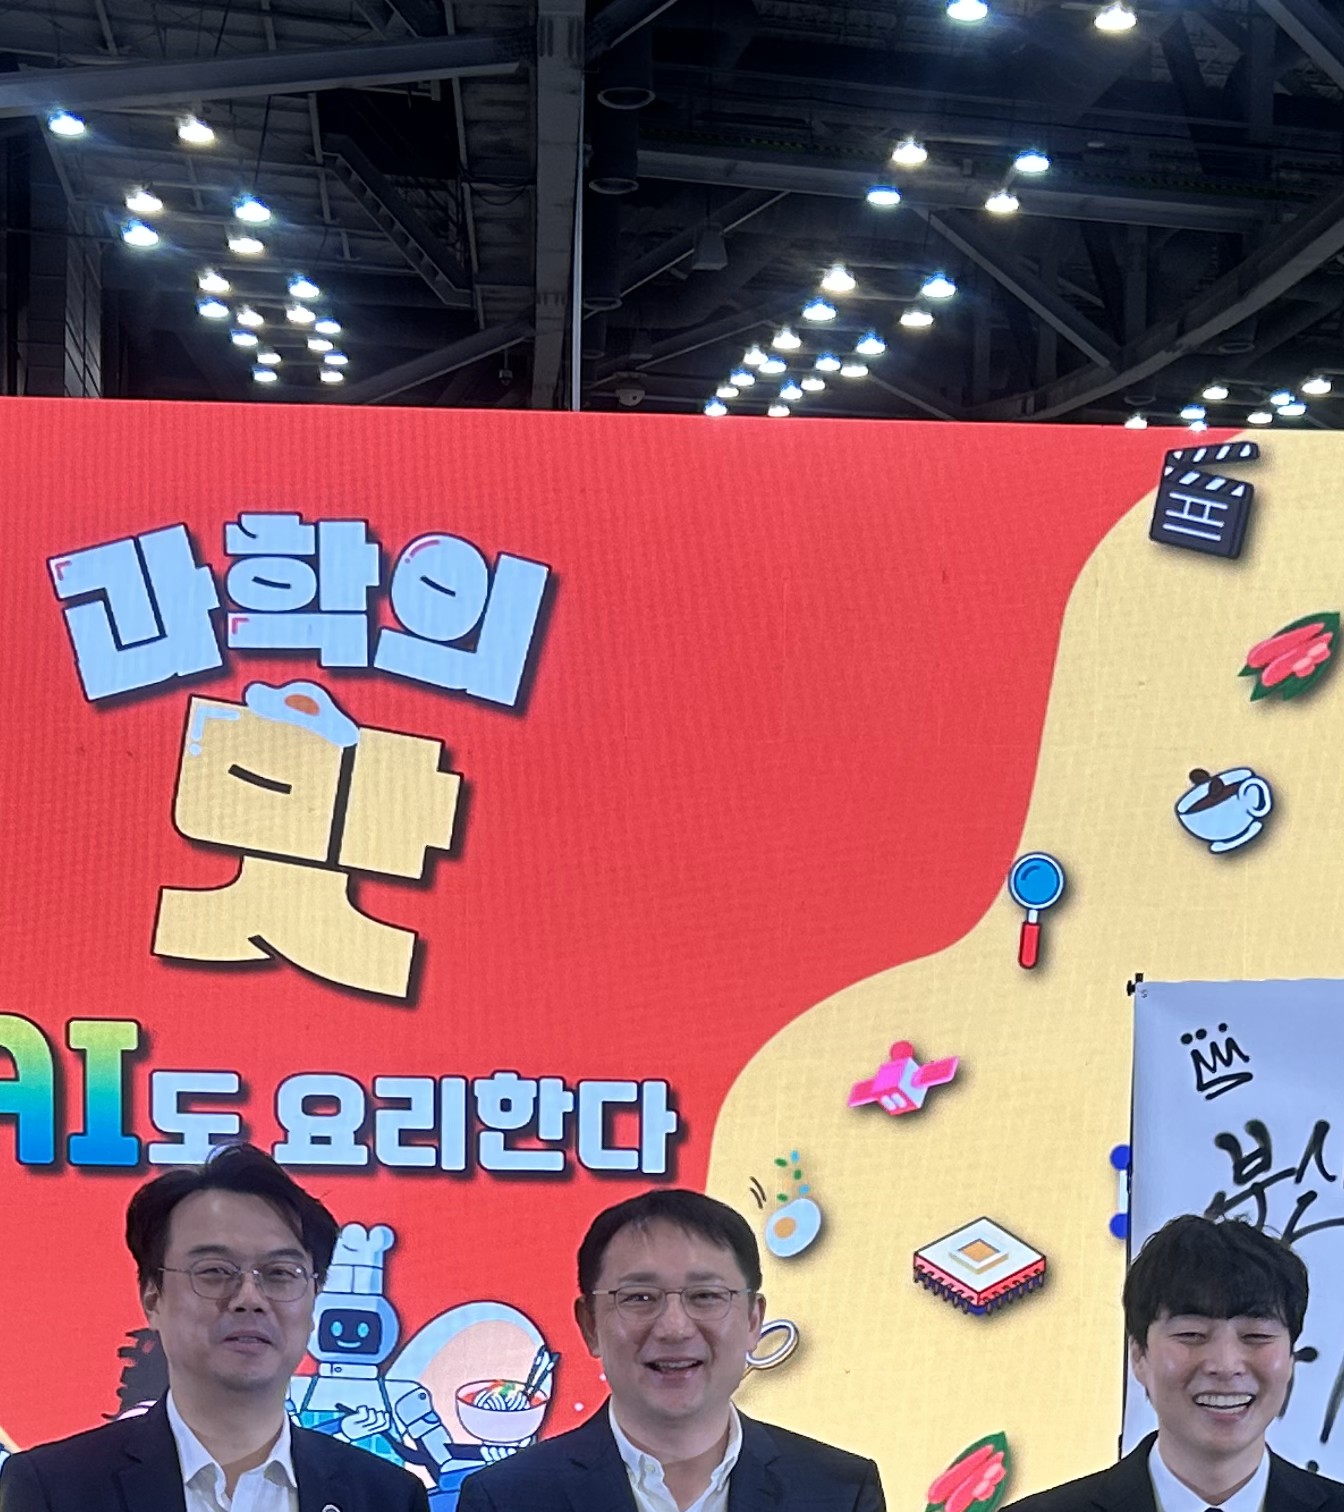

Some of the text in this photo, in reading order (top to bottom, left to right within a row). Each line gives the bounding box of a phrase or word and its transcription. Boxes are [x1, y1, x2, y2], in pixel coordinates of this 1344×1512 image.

[48, 511, 551, 707] 과학의
[151, 682, 464, 1000] 맛
[273, 1071, 678, 1175] 요리한다
